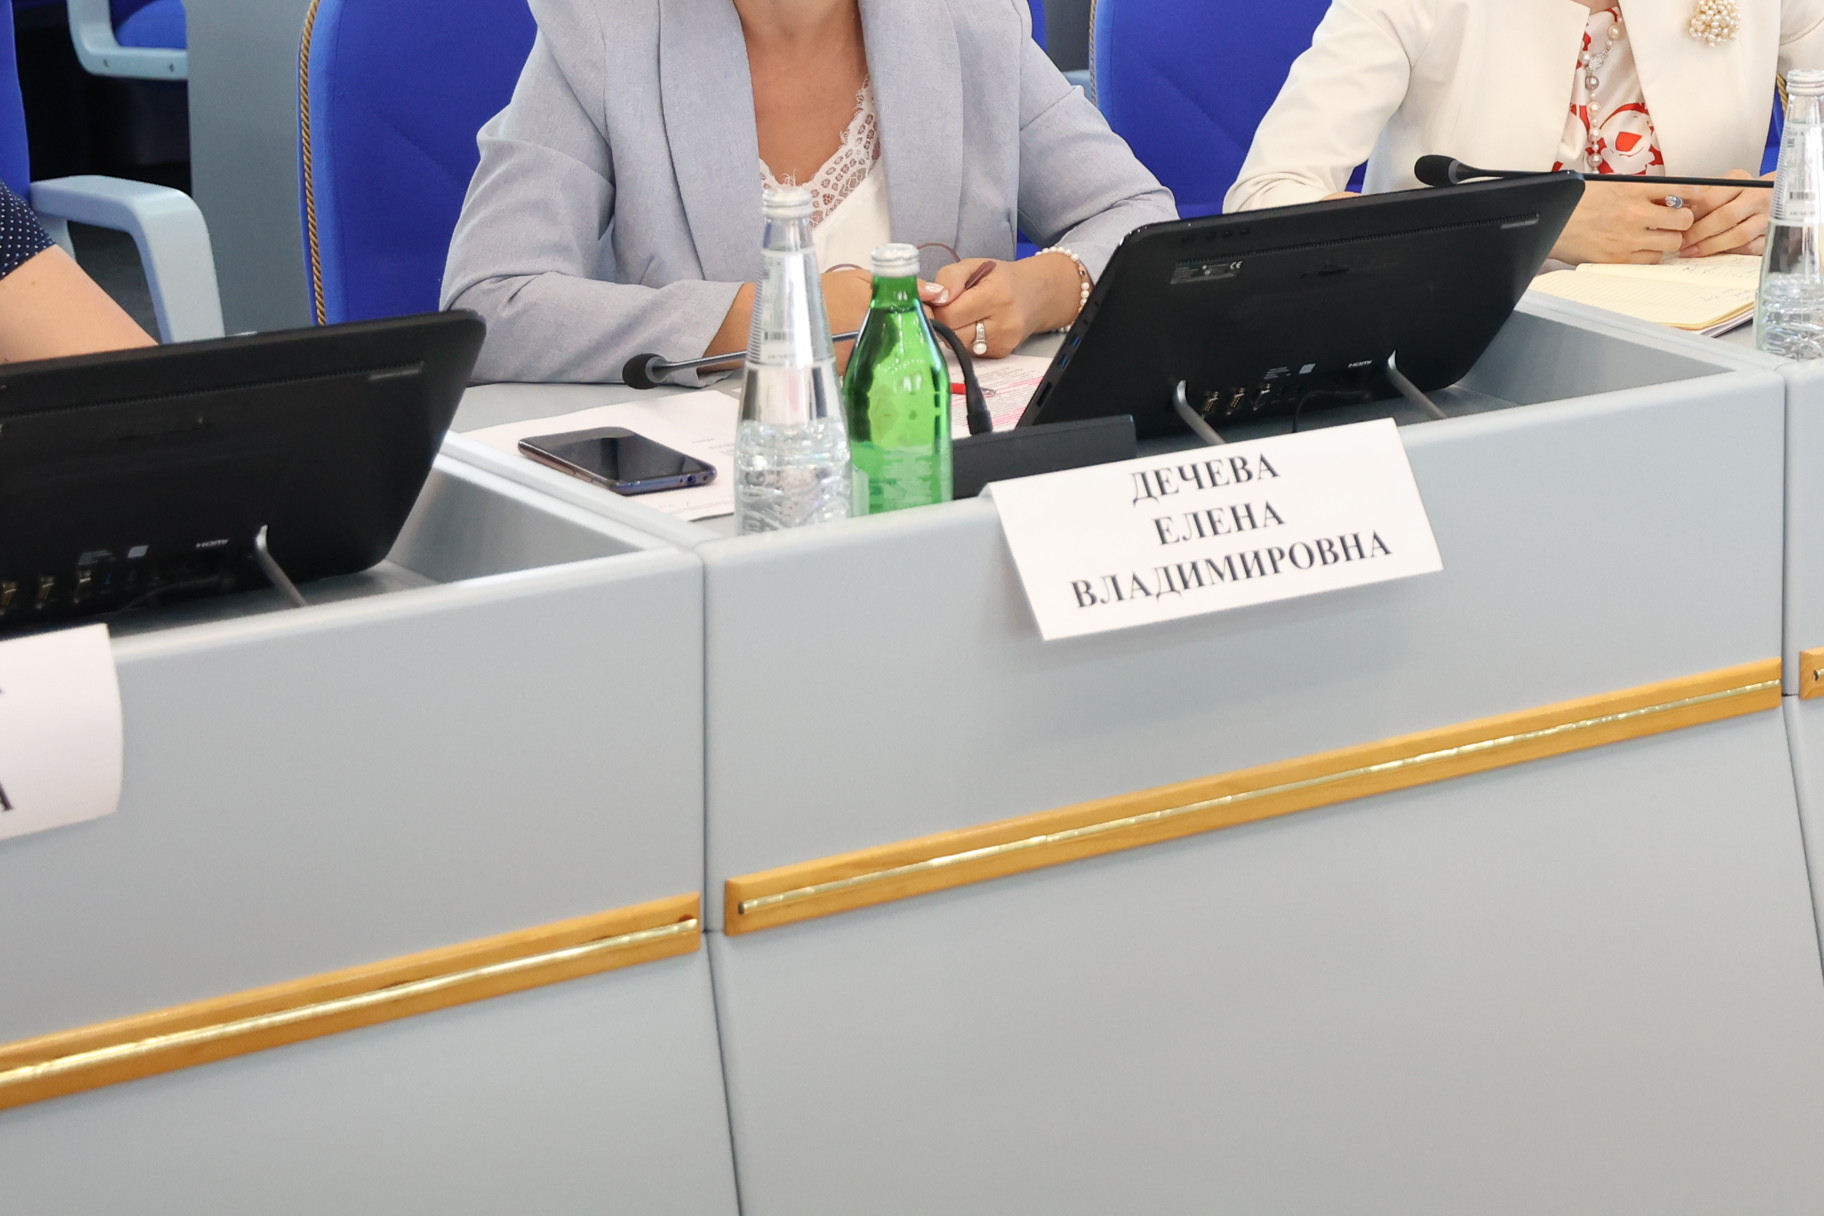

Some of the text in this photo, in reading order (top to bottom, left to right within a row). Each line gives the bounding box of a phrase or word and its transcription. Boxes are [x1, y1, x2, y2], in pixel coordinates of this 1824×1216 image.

[1132, 453, 1279, 505] ДЕЧЕВА
[1153, 501, 1285, 546] ЕЛЕНА
[1071, 531, 1392, 608] ВЛАДИМИРОВНА
